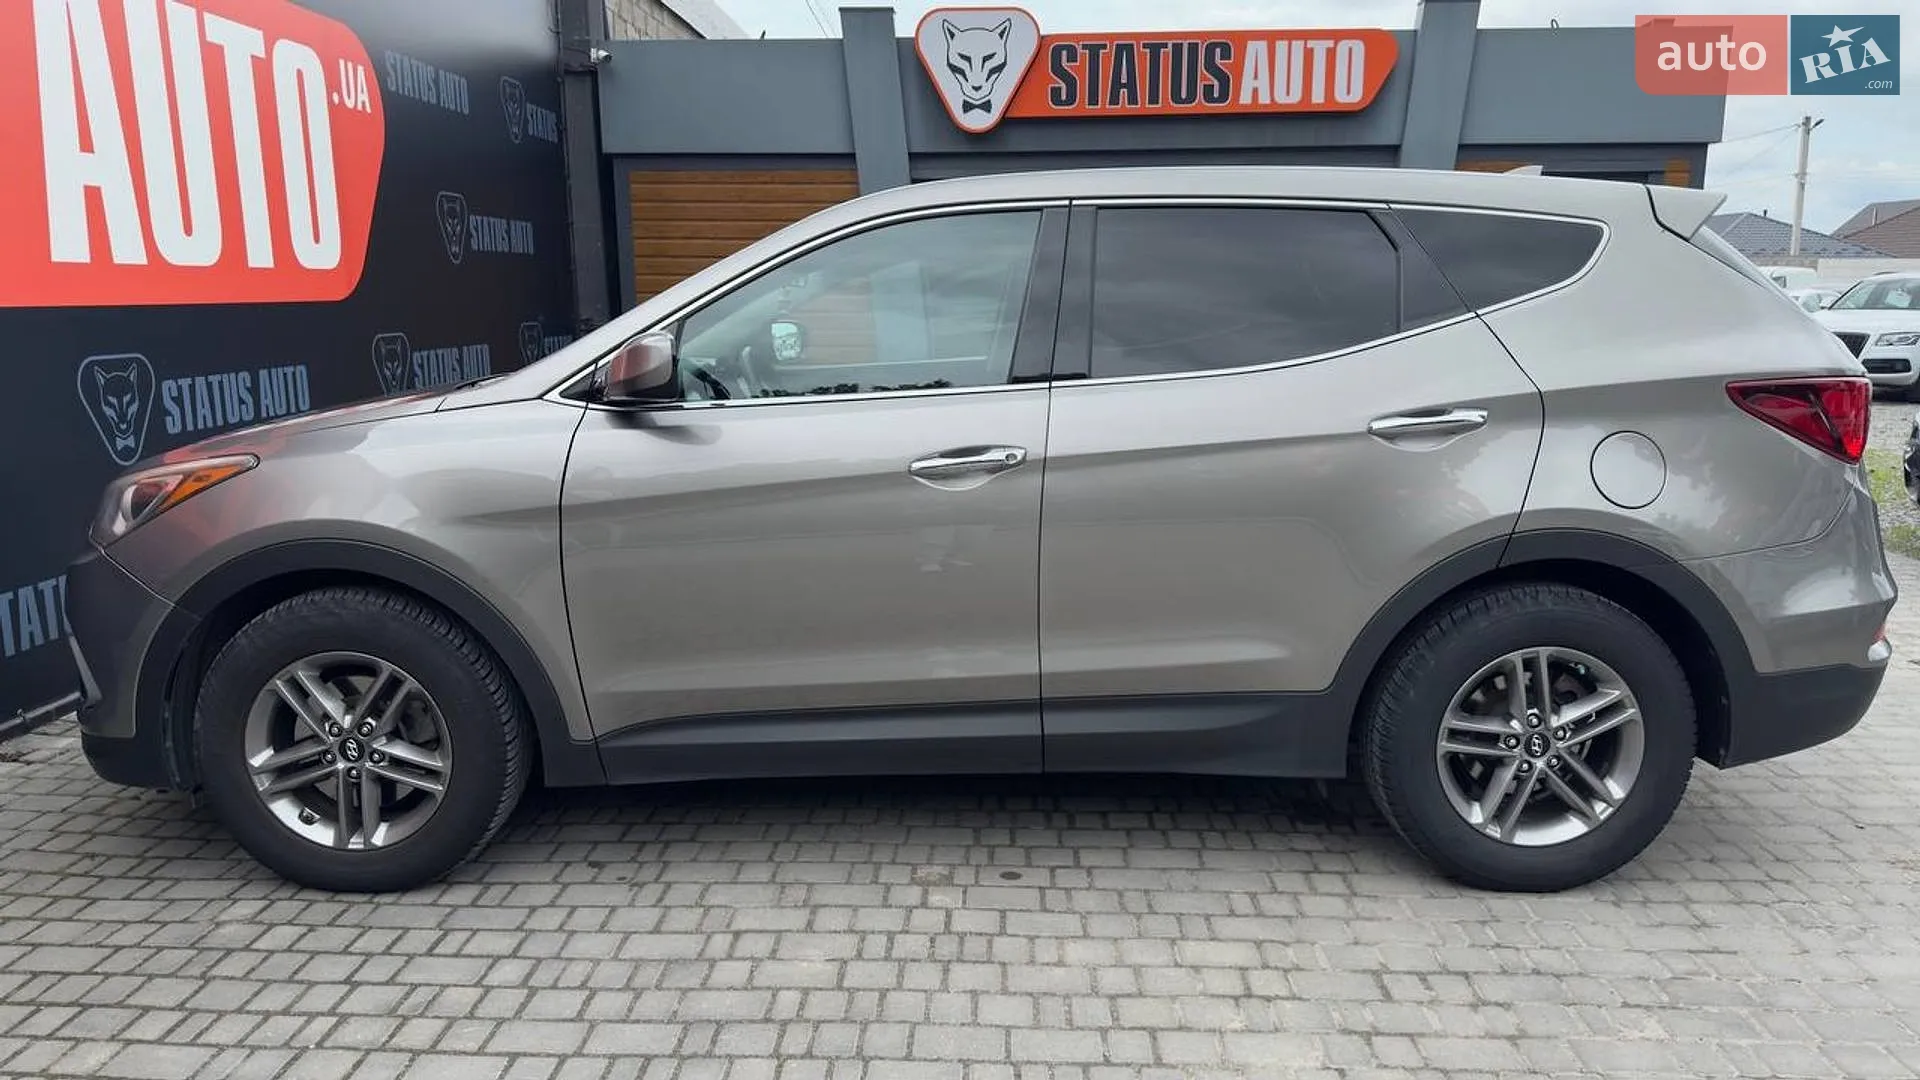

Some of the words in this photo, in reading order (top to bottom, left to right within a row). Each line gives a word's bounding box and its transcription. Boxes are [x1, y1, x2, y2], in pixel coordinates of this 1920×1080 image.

[384, 49, 437, 105] STATUS
[439, 69, 470, 115] AUTO
[1047, 40, 1233, 109] STATUS
[1238, 39, 1366, 105] AUTO
[32, 0, 341, 269] AUTO
[469, 214, 510, 252] STATUS
[161, 371, 255, 434] STATUS
[258, 364, 311, 418] AUTO
[412, 347, 461, 390] STATUS
